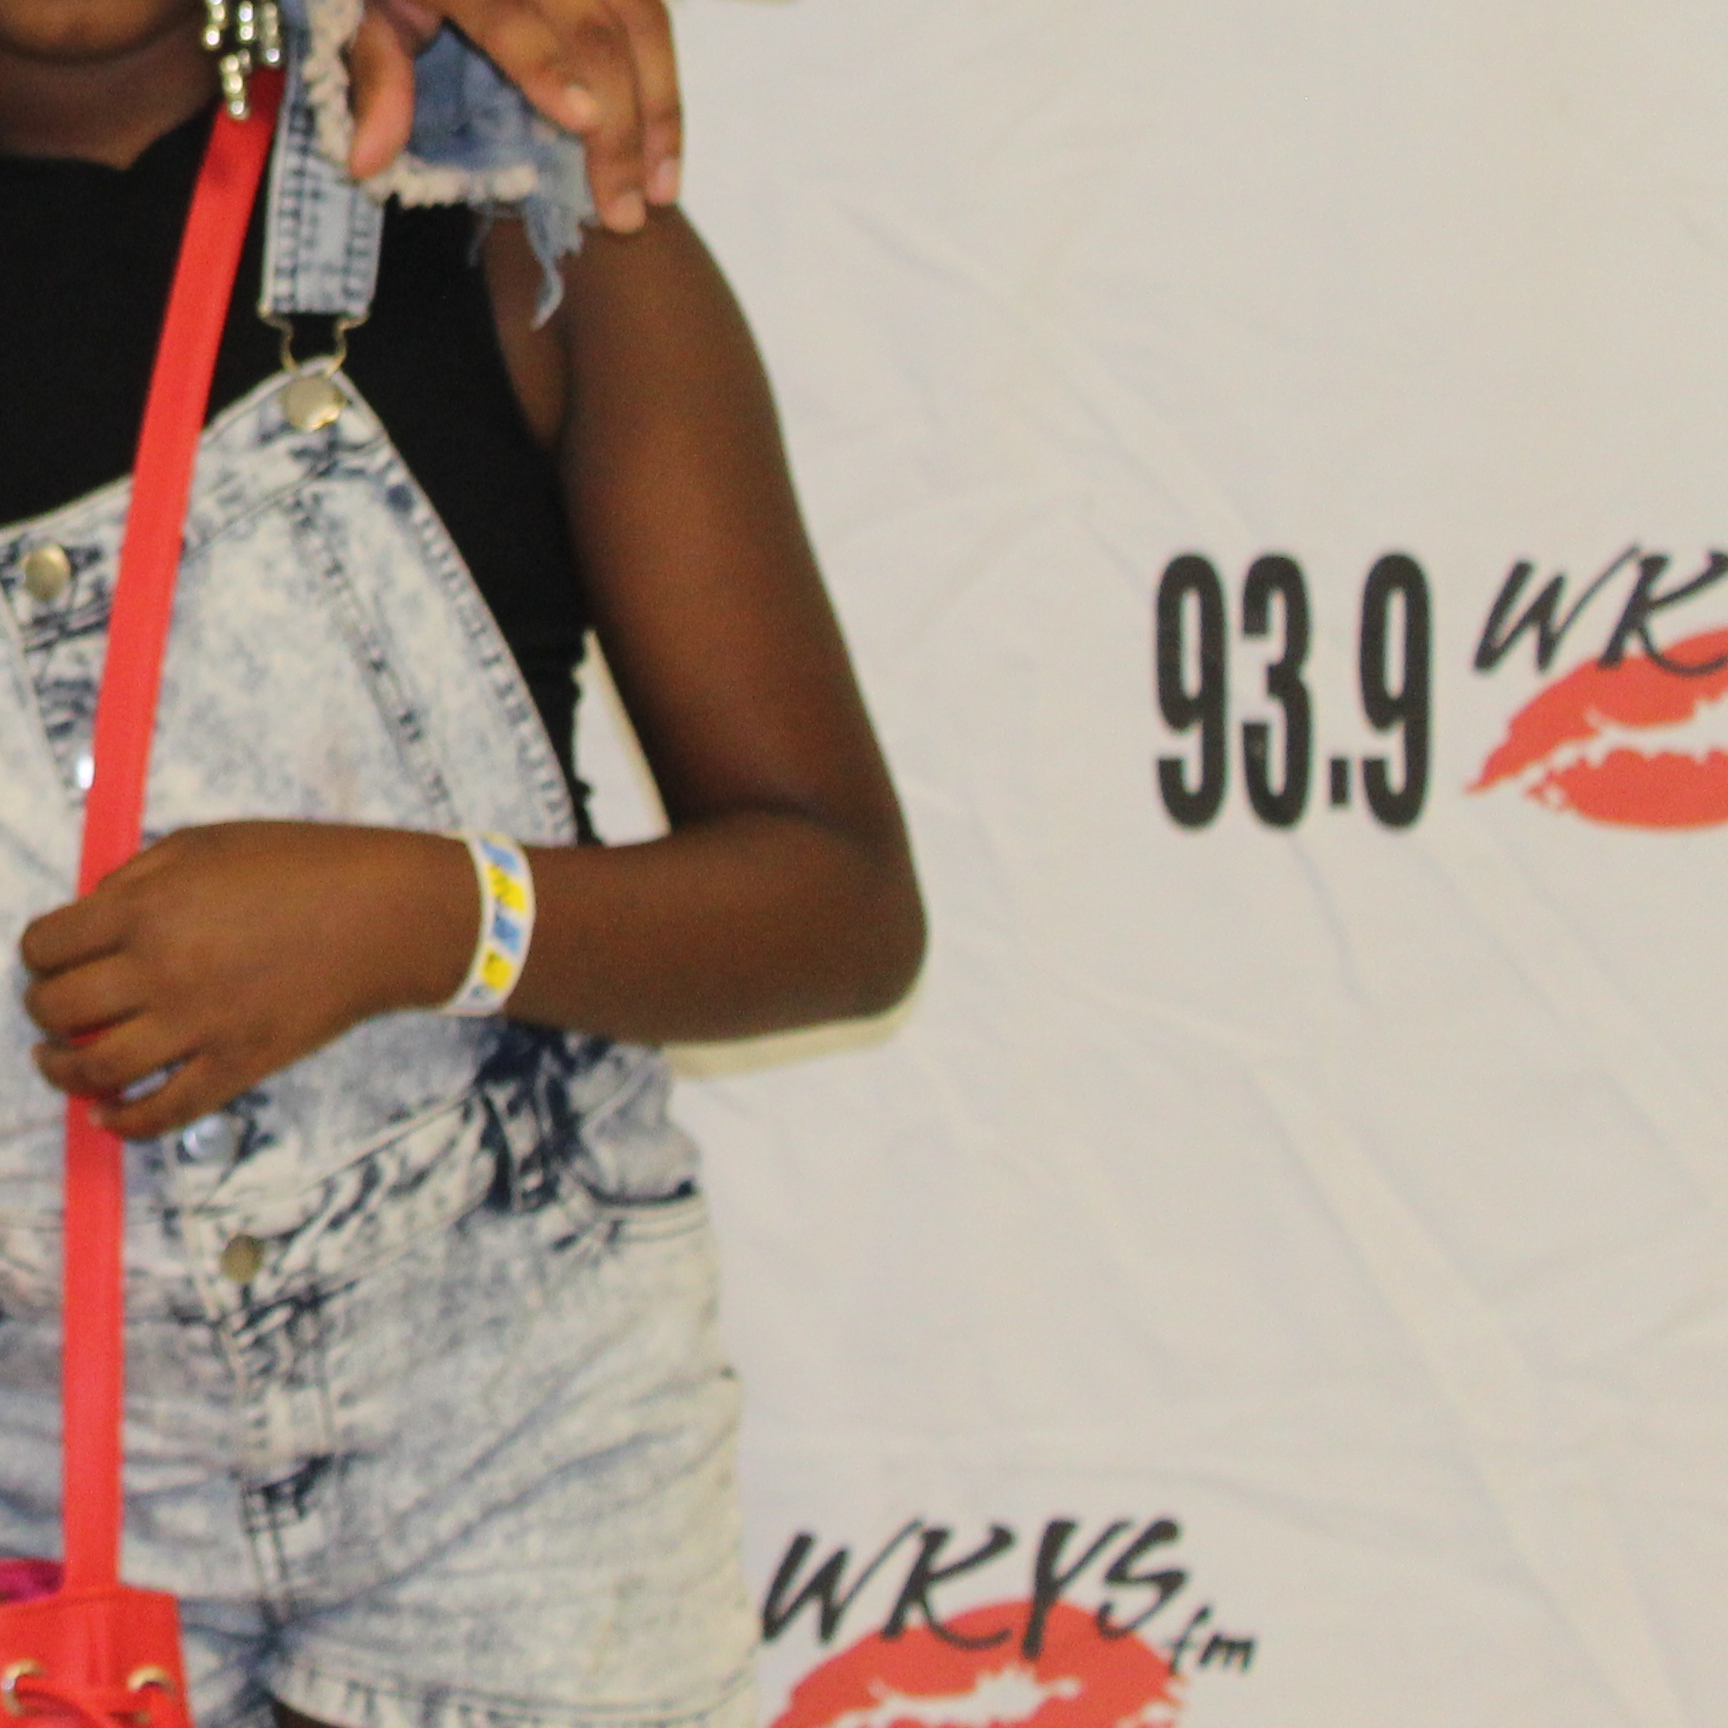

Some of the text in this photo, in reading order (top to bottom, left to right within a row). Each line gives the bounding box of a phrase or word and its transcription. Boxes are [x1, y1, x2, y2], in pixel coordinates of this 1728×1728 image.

[1155, 542, 1728, 830] 93.9 WK
[759, 1517, 1187, 1660] WKYS
